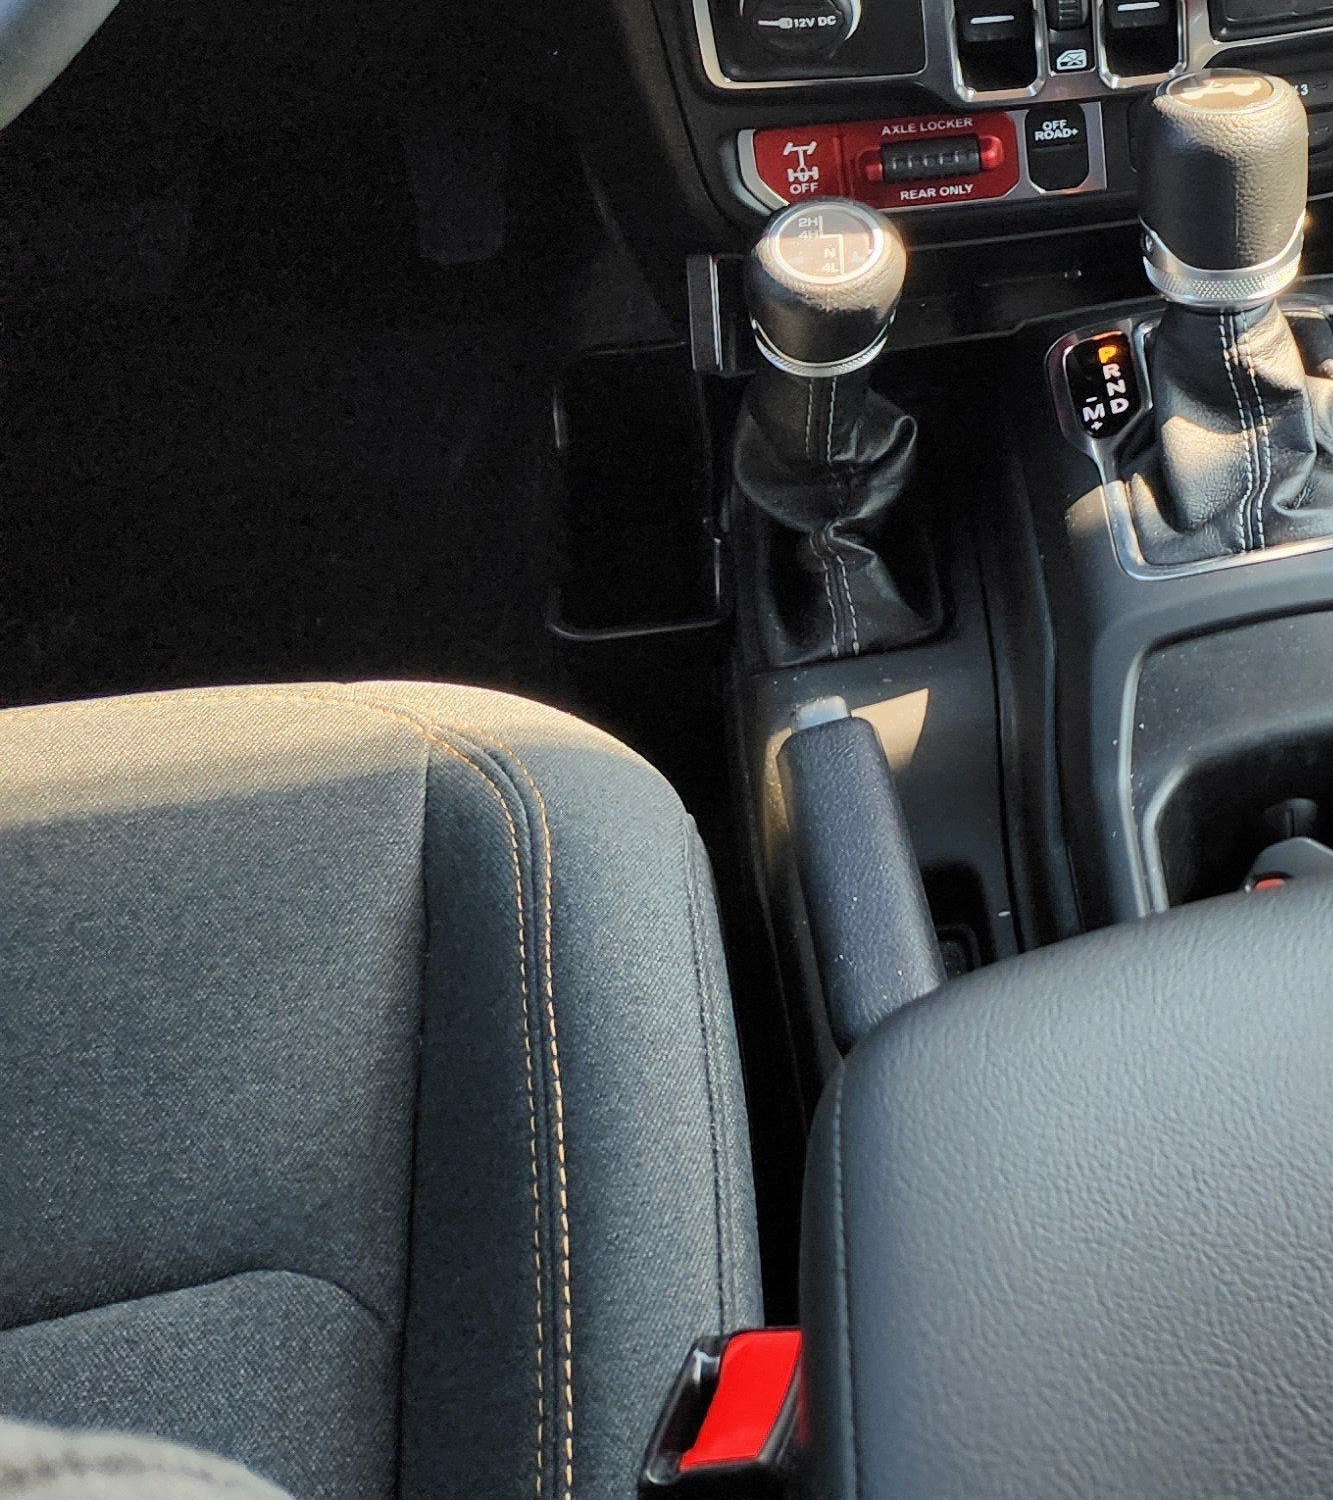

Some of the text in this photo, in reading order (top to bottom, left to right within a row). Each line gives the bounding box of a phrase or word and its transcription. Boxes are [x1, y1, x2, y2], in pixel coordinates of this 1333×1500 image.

[794, 15, 837, 28] 12V DC
[1300, 83, 1309, 96] 3
[881, 117, 974, 136] AXLE LOCKER
[1042, 119, 1067, 131] OFF
[789, 181, 820, 195] OFF
[899, 184, 974, 200] REAR ONLY
[798, 217, 818, 227] 2H
[824, 247, 836, 258] N
[1098, 345, 1117, 363] P
[1103, 363, 1121, 380] R
[1106, 379, 1126, 396] N
[1082, 403, 1106, 422] M
[1109, 397, 1130, 414] D
